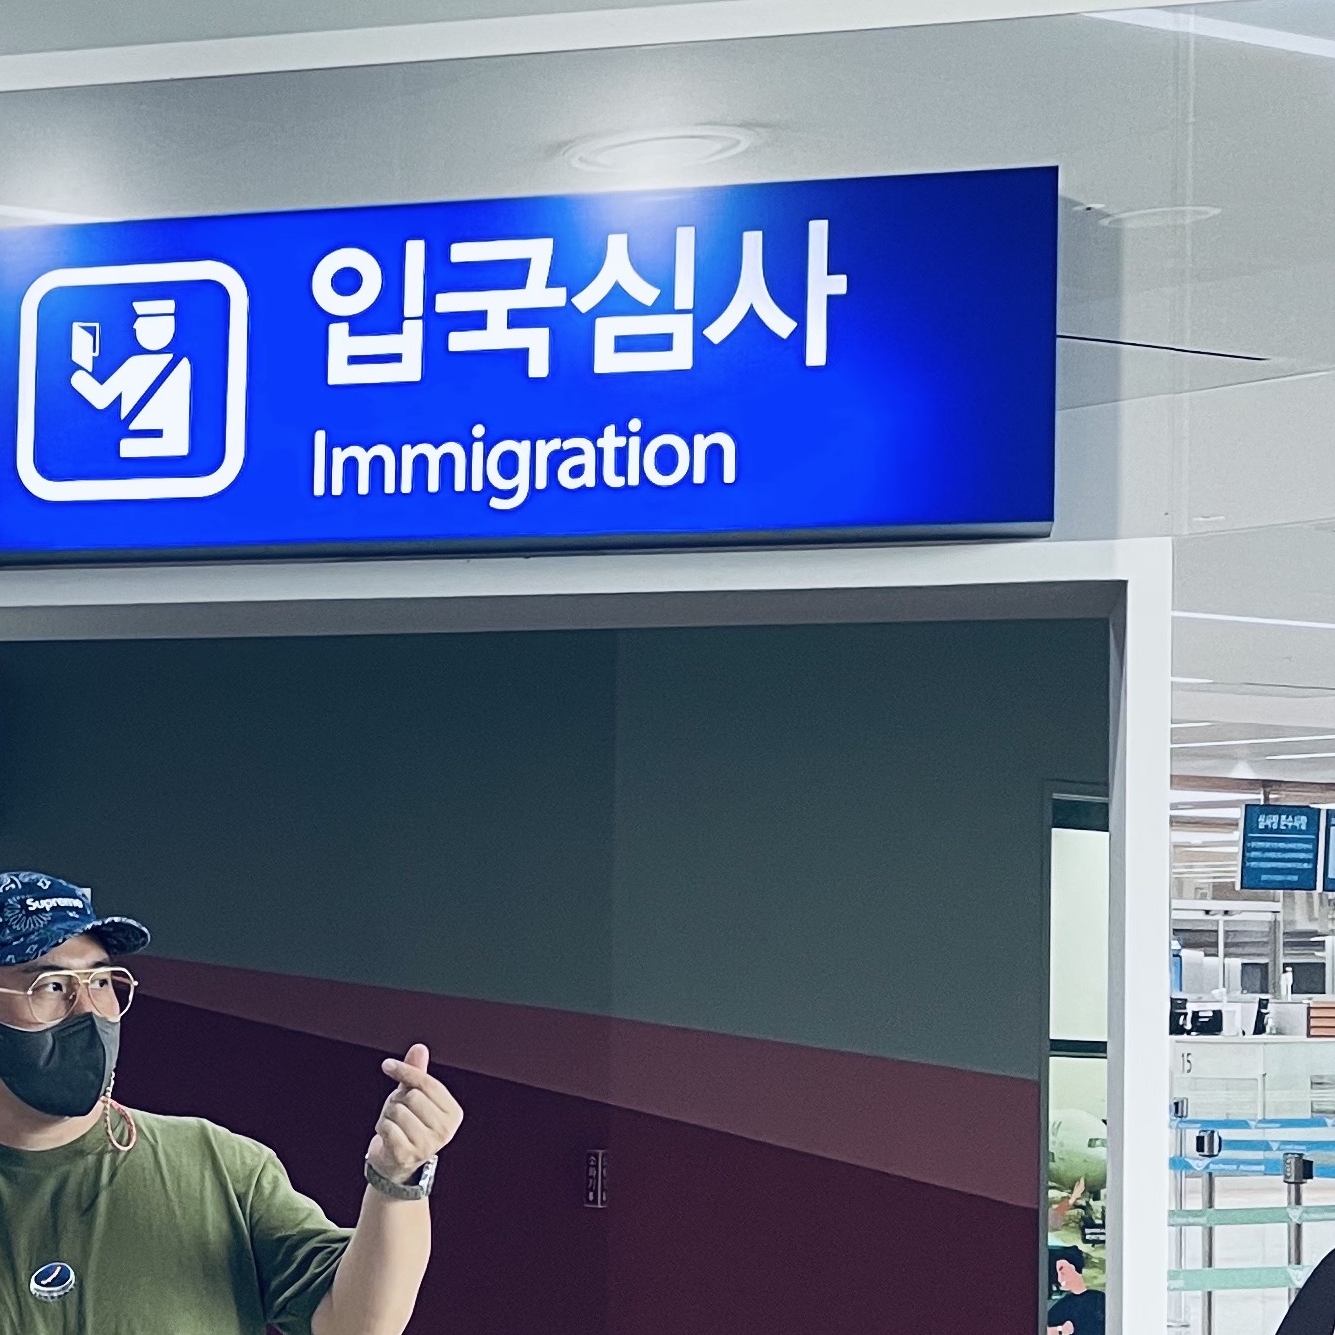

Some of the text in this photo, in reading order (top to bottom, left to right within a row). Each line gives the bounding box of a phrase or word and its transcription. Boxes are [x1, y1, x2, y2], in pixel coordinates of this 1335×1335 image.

[312, 219, 847, 385] 입국심사
[313, 418, 737, 509] Immigration
[25, 897, 84, 912] Supreme
